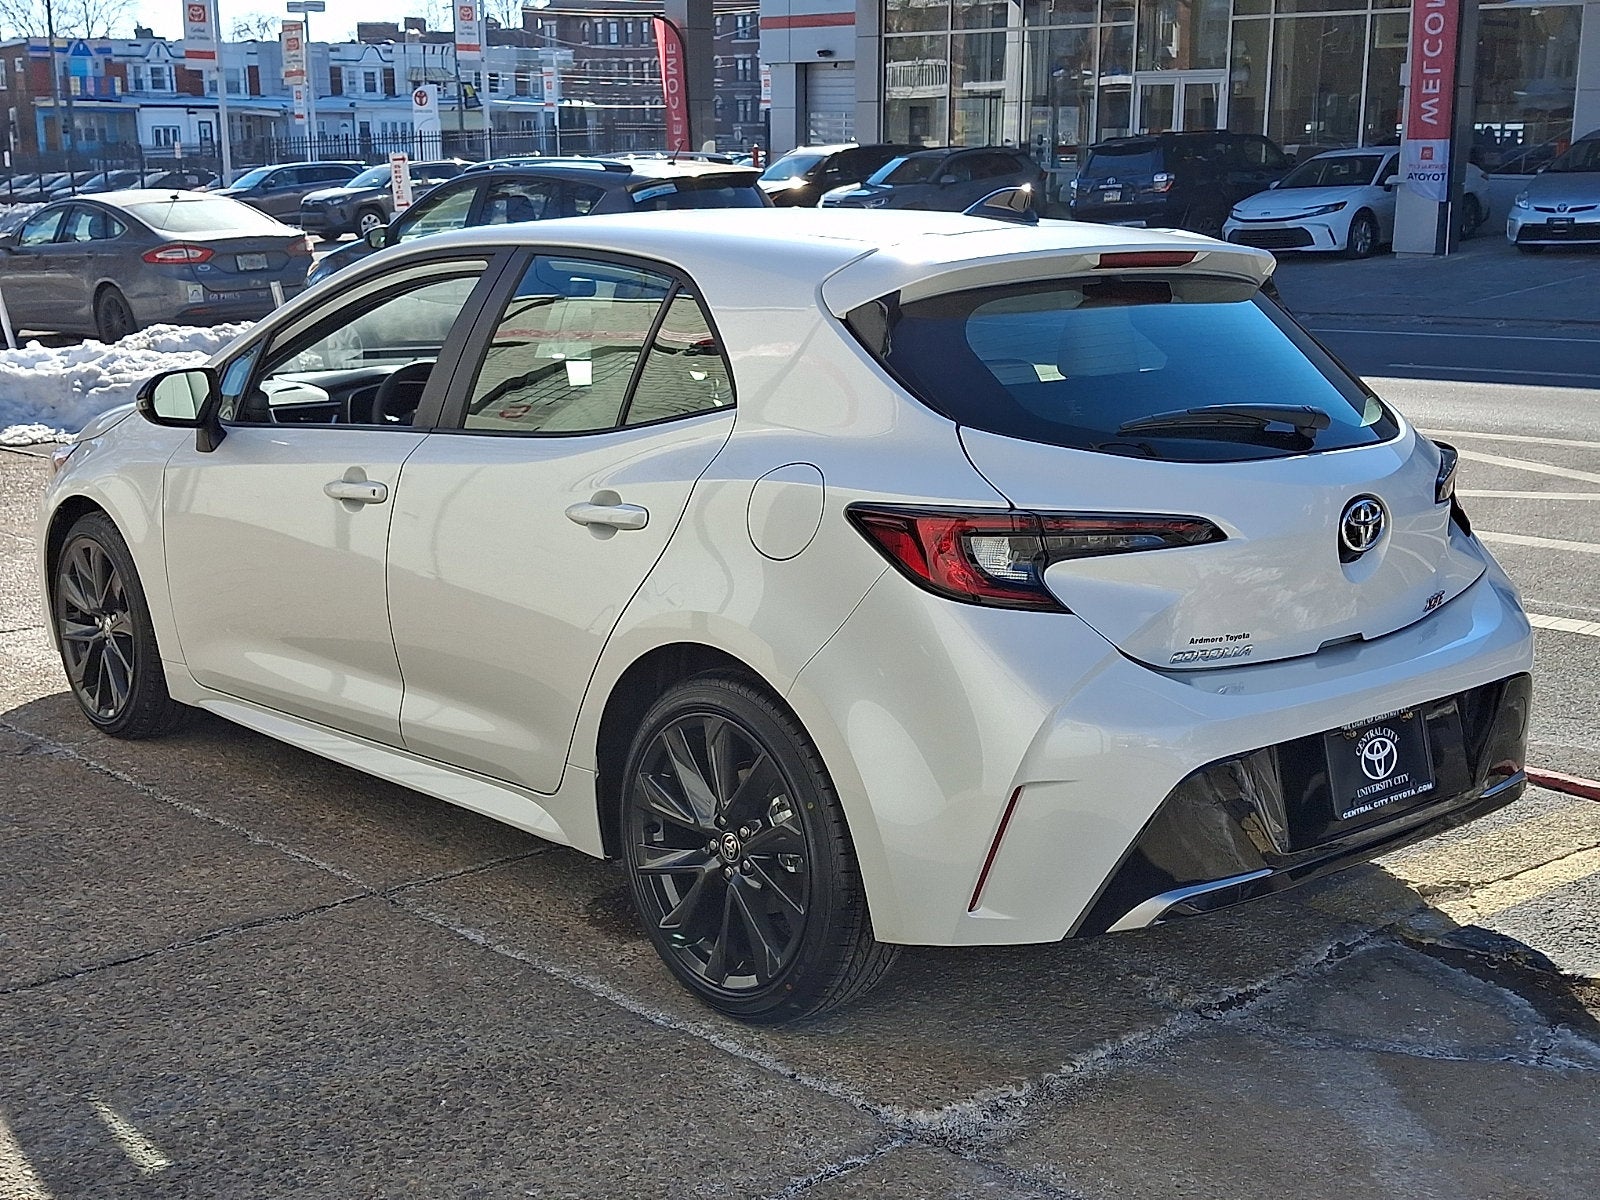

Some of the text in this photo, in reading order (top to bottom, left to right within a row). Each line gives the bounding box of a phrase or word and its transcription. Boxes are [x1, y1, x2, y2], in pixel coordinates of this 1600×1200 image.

[1189, 632, 1250, 645] Ardmore Toyota
[1169, 644, 1254, 664] COROLLA
[1355, 727, 1401, 757] CENTRAL CITY
[1356, 773, 1409, 798] UNIVERSITY CITY
[1342, 803, 1374, 819] CENTRAL
[1373, 798, 1389, 808] CITY
[1390, 788, 1416, 803] TOYOTA
